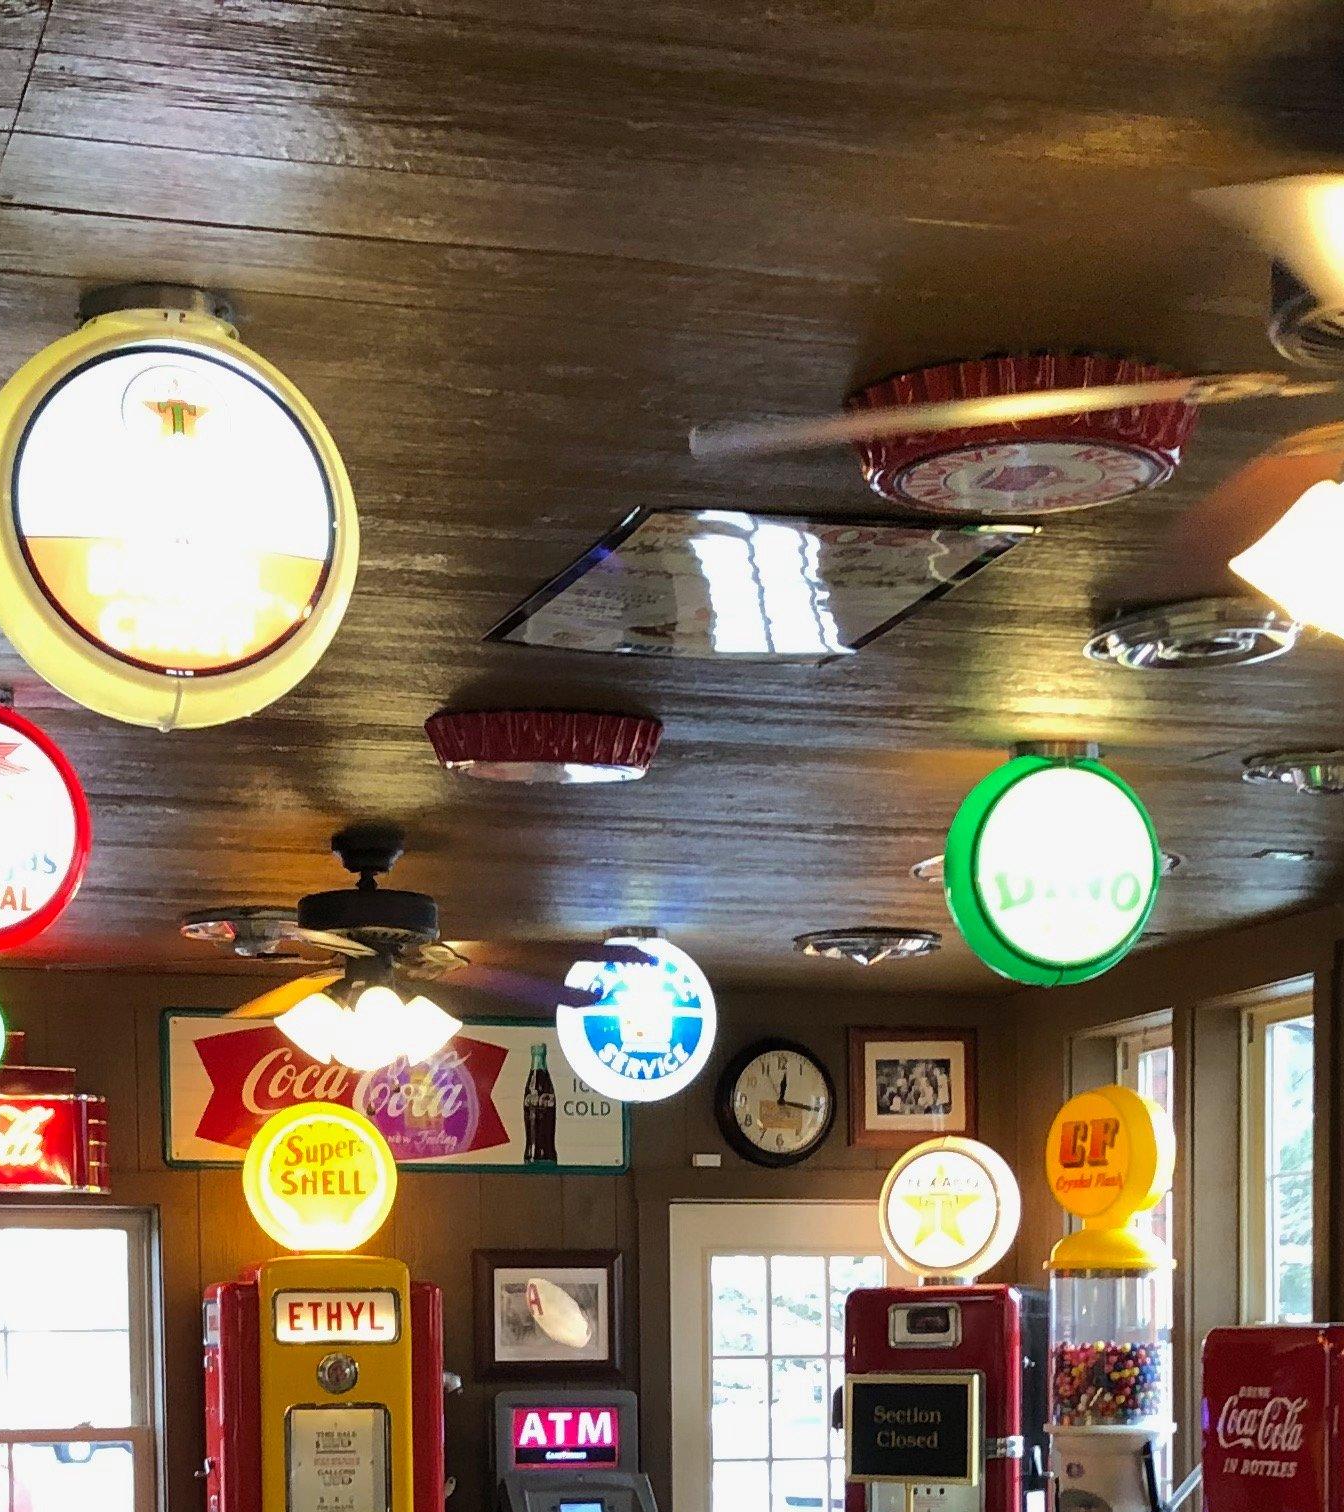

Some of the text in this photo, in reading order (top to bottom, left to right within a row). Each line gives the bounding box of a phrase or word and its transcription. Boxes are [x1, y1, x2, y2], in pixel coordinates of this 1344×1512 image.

[599, 1042, 690, 1080] SERVICE
[563, 1101, 611, 1116] COLD
[281, 1170, 366, 1195] SHELL
[288, 1301, 384, 1330] ETHYL
[874, 1404, 942, 1425] Section
[1217, 1394, 1308, 1451] Coca-Cola
[519, 1411, 613, 1446] ATM
[876, 1430, 938, 1449] Closed
[1223, 1457, 1298, 1478] IN BOTTLES
